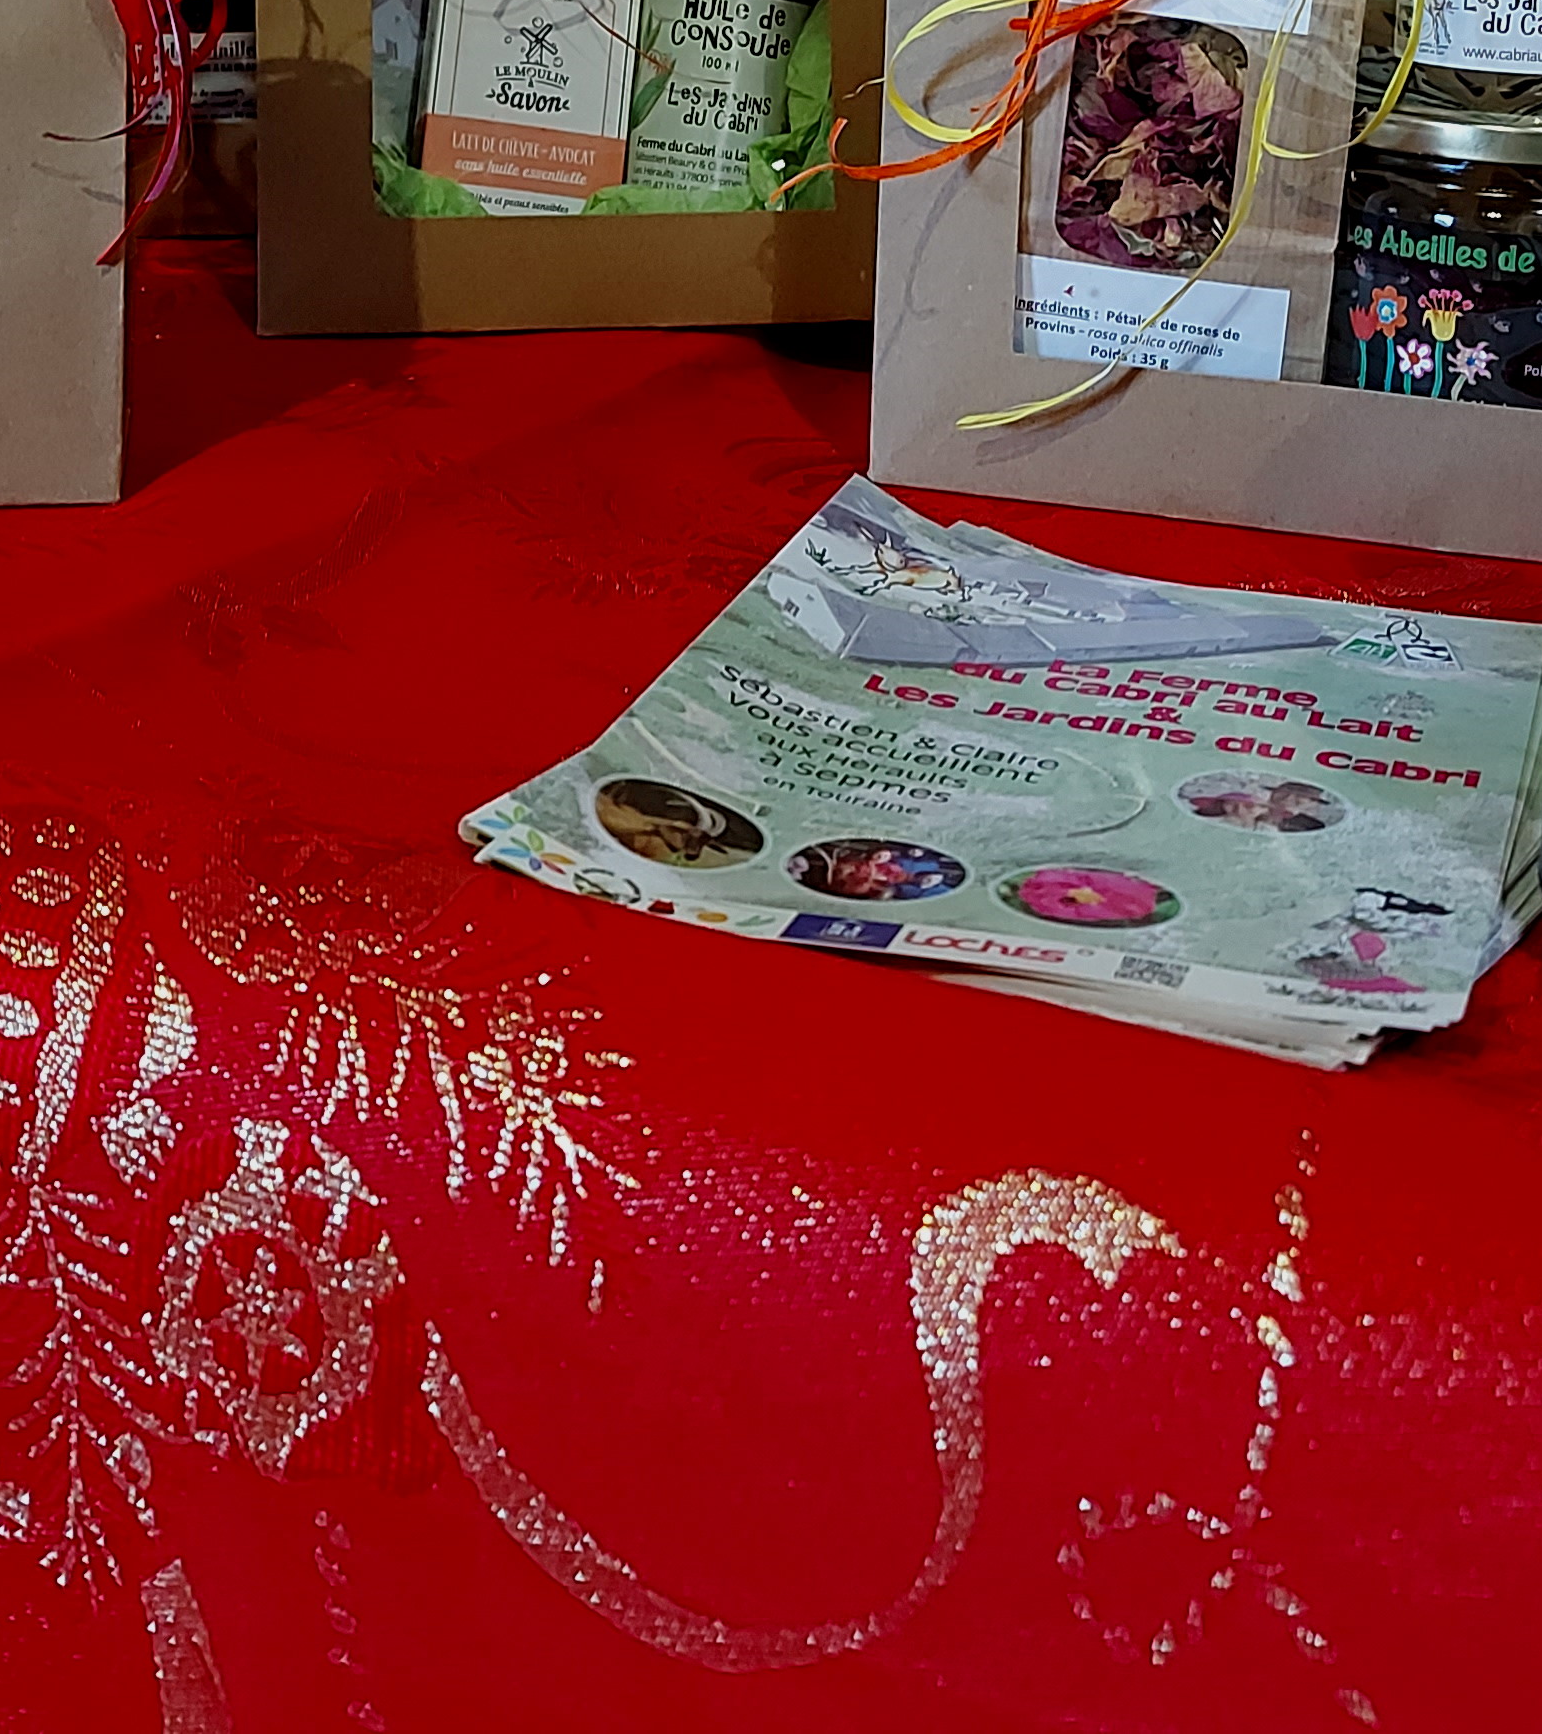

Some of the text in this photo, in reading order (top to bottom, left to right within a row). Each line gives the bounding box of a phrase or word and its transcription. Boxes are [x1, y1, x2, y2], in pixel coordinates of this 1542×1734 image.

[759, 4, 786, 30] de
[702, 55, 722, 69] 100
[515, 66, 570, 86] MOULIN
[495, 82, 560, 112] Savon
[452, 130, 480, 149] LAIT
[483, 134, 495, 153] DE
[549, 145, 597, 167] AVOCAT
[668, 139, 683, 152] du
[522, 166, 588, 186] essentielle
[1380, 225, 1488, 269] Abeilles
[1497, 244, 1535, 274] de
[1025, 317, 1117, 342] Provins rosa
[1160, 319, 1178, 333] de
[1181, 322, 1219, 338] roses
[1222, 328, 1240, 341] de
[1140, 353, 1156, 366] 35
[1048, 658, 1321, 708] La Ferme
[951, 661, 1425, 745] du Cabri au Lait
[1141, 703, 1185, 725] &
[862, 673, 1483, 791] Les Jardins du Cabri
[913, 735, 938, 751] &
[757, 730, 816, 760] aux
[762, 775, 922, 816] en Touraine
